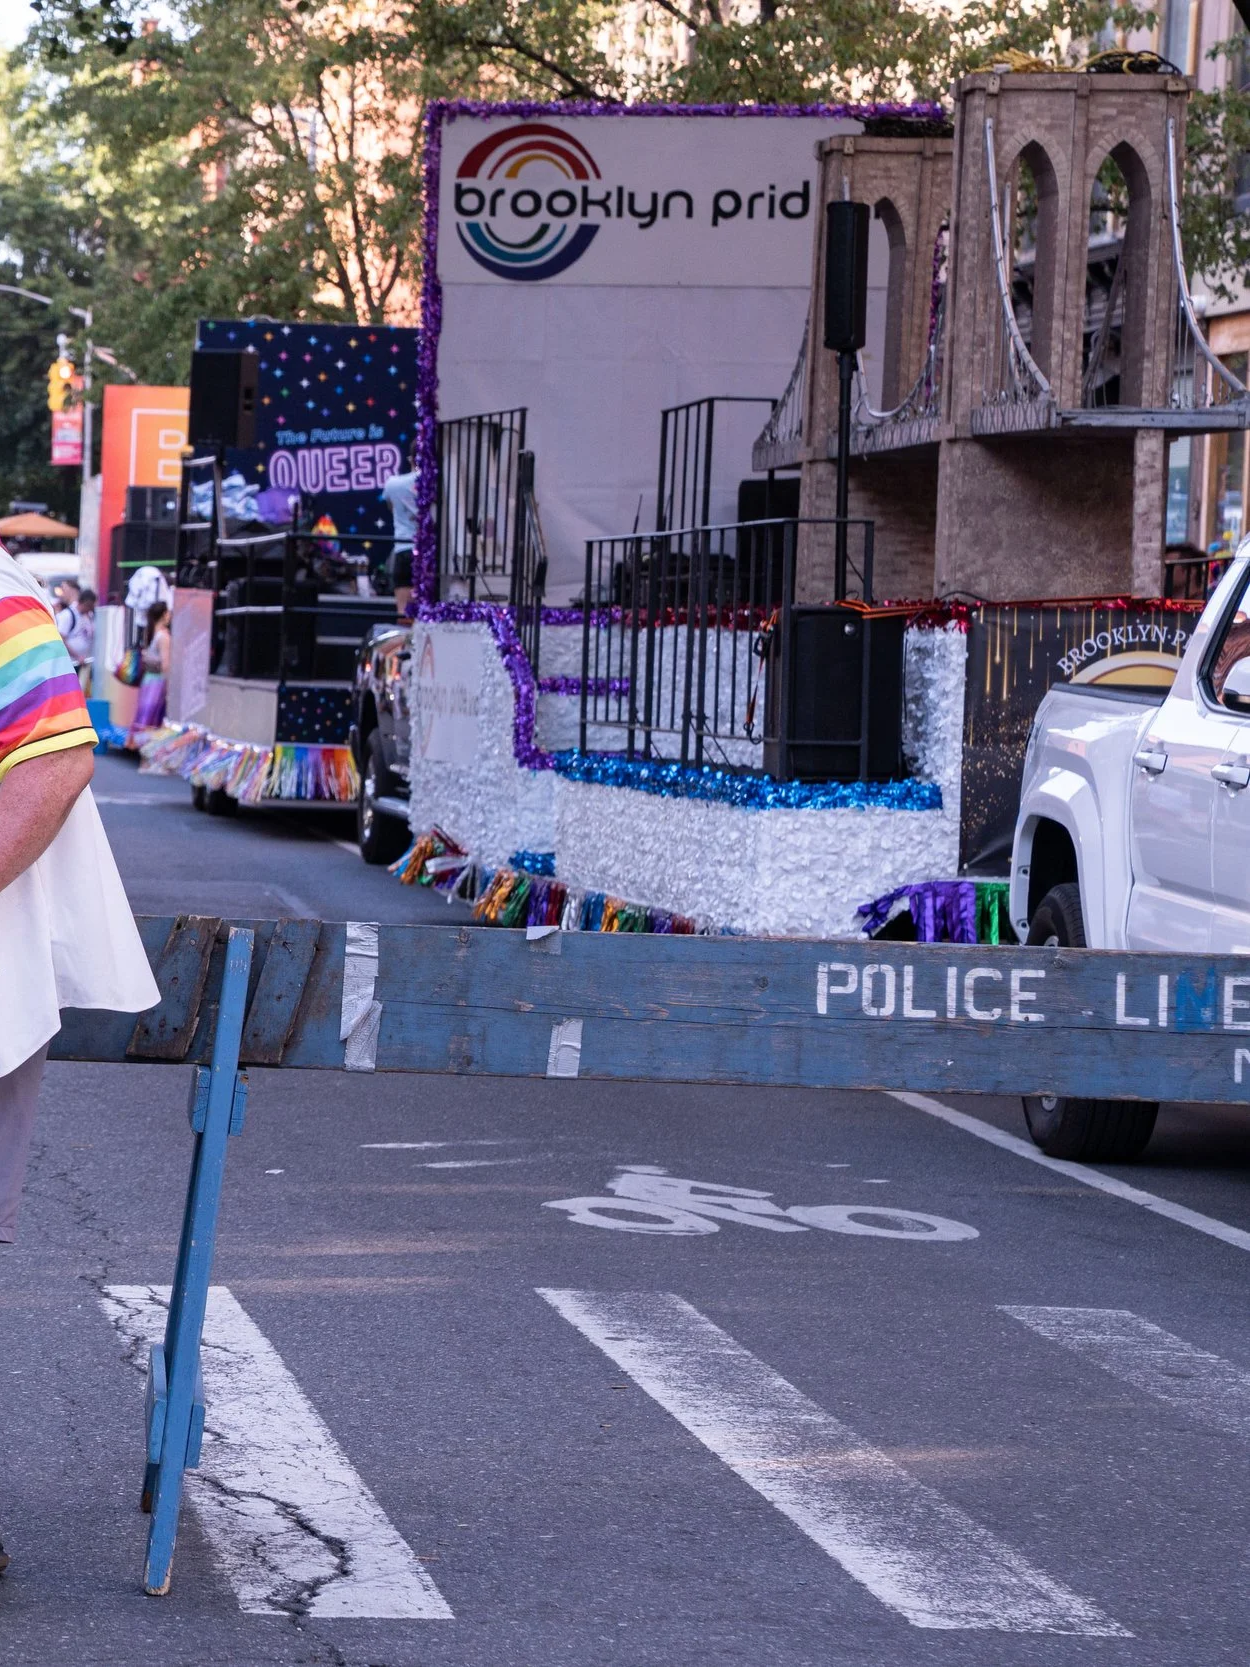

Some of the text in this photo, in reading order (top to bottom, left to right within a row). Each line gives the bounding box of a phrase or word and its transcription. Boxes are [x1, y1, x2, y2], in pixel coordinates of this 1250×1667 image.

[454, 180, 810, 229] brooklyn prid
[276, 423, 384, 446] The Future is
[269, 443, 401, 494] QUEER
[817, 962, 1046, 1021] POLICE
